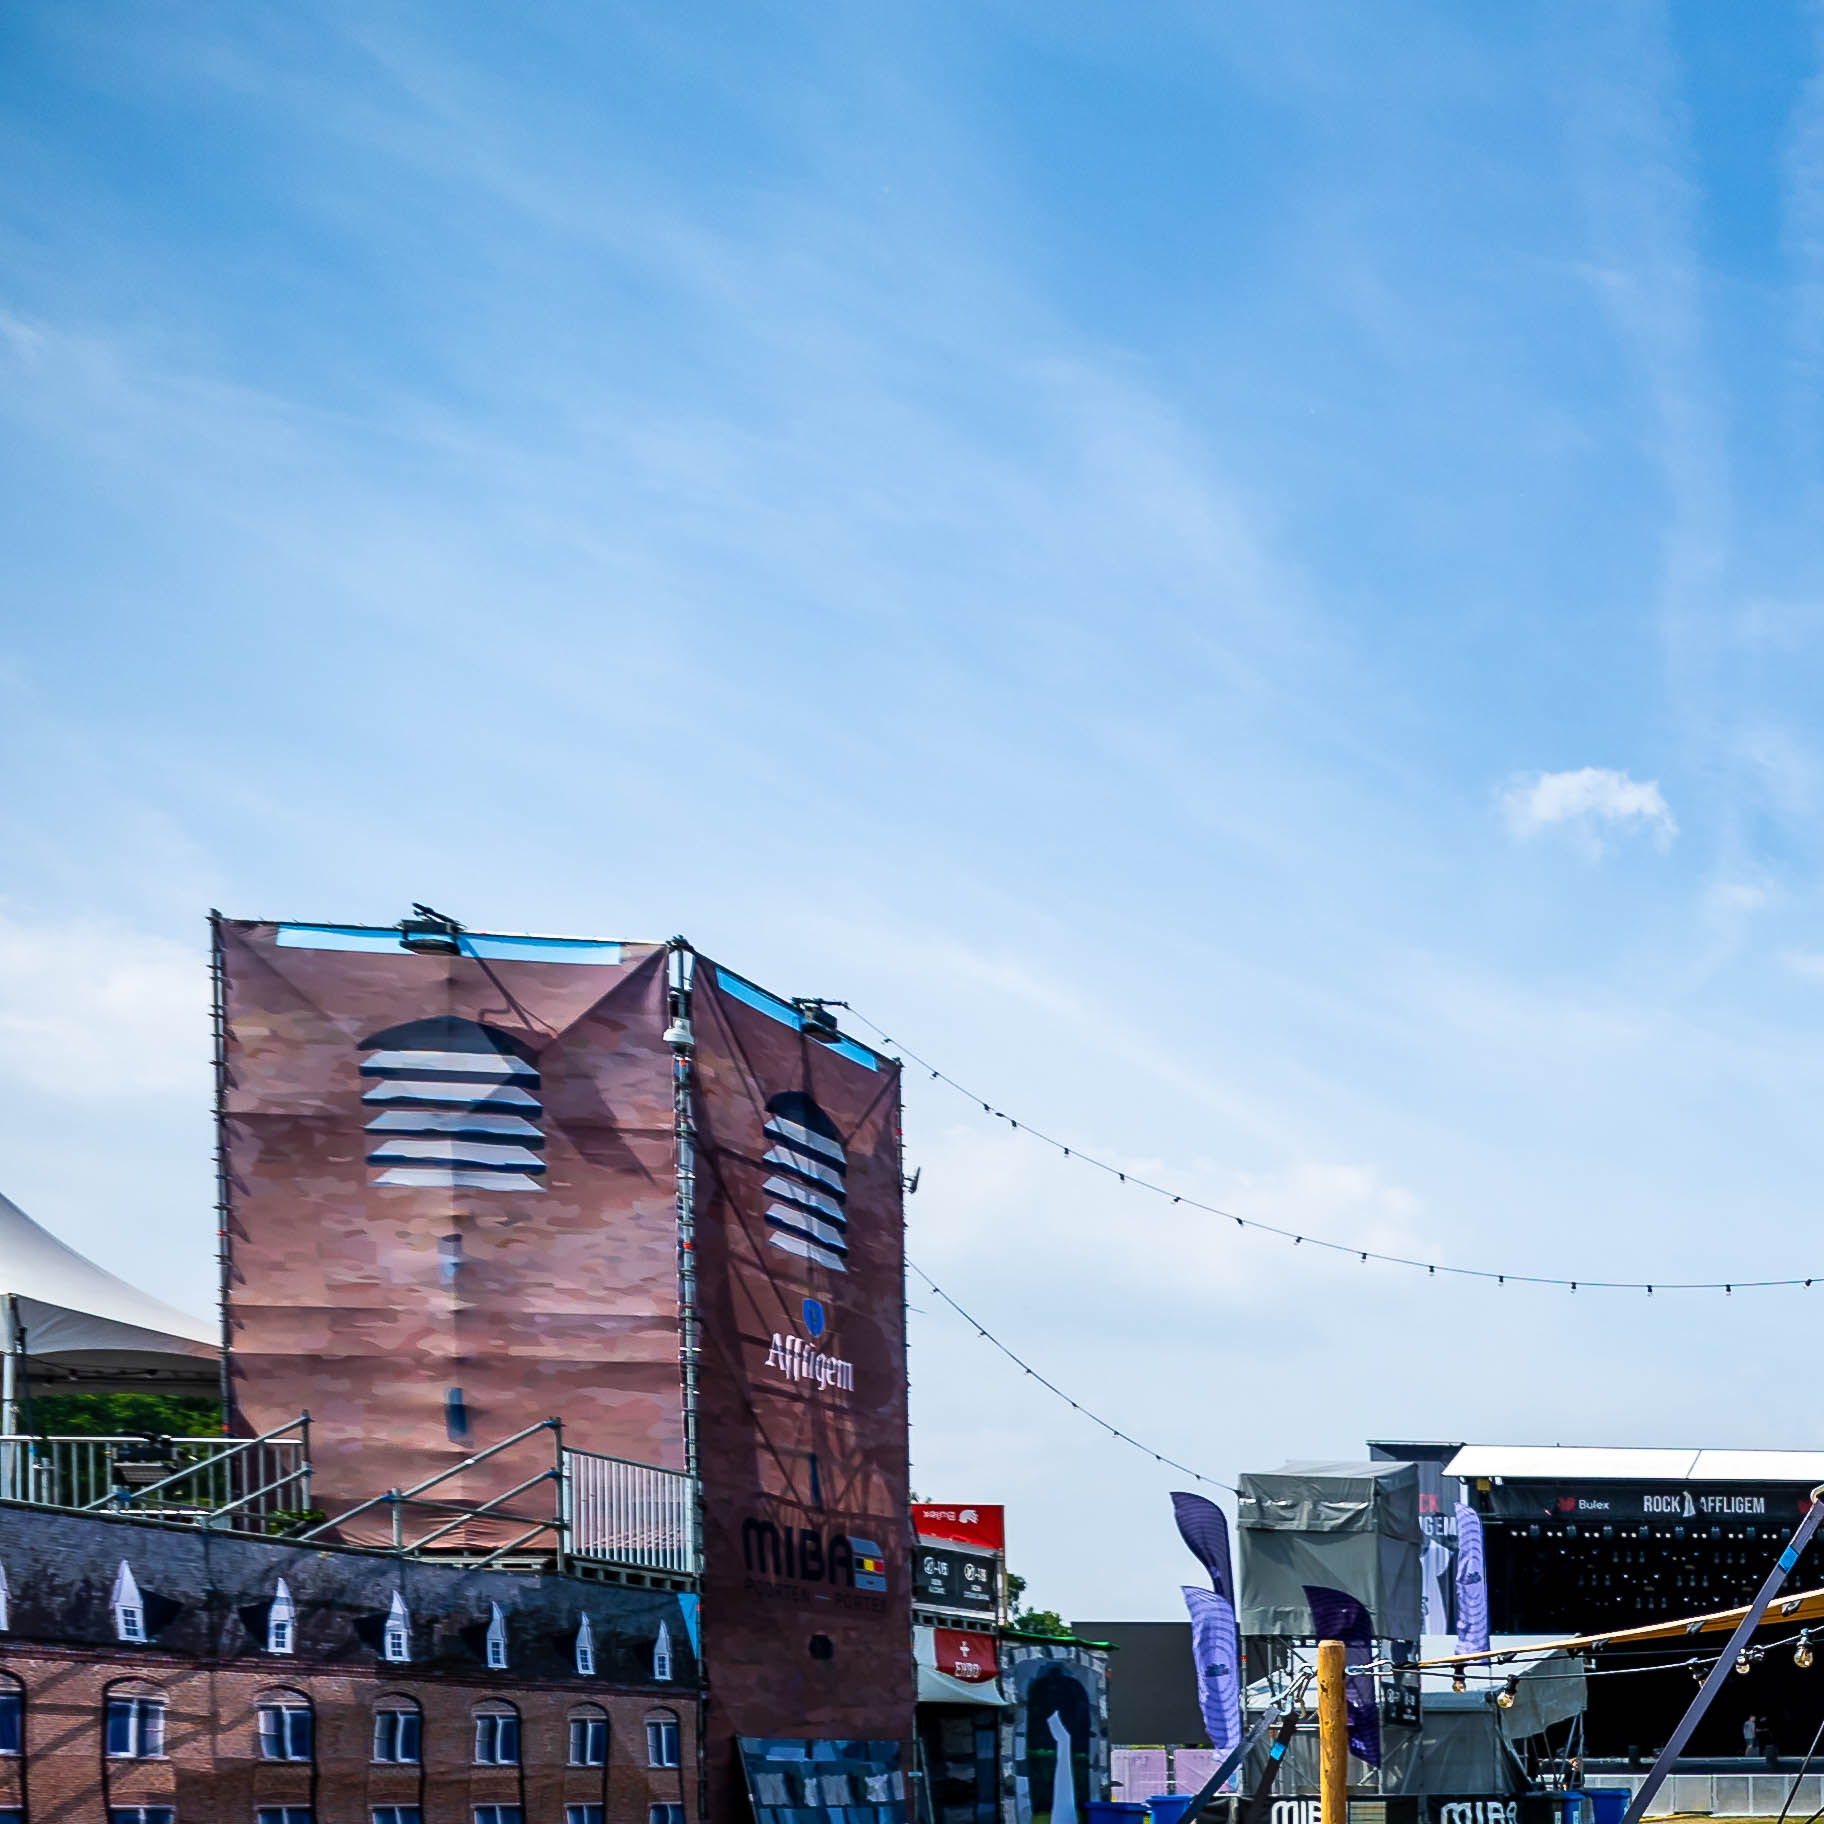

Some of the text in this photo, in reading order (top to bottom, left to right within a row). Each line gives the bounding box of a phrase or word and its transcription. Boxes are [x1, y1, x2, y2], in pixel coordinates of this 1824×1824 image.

[764, 1333, 854, 1392] Affligem
[1578, 1499, 1610, 1510] Bulex
[1643, 1495, 1765, 1513] ROCK AFFLIGEM
